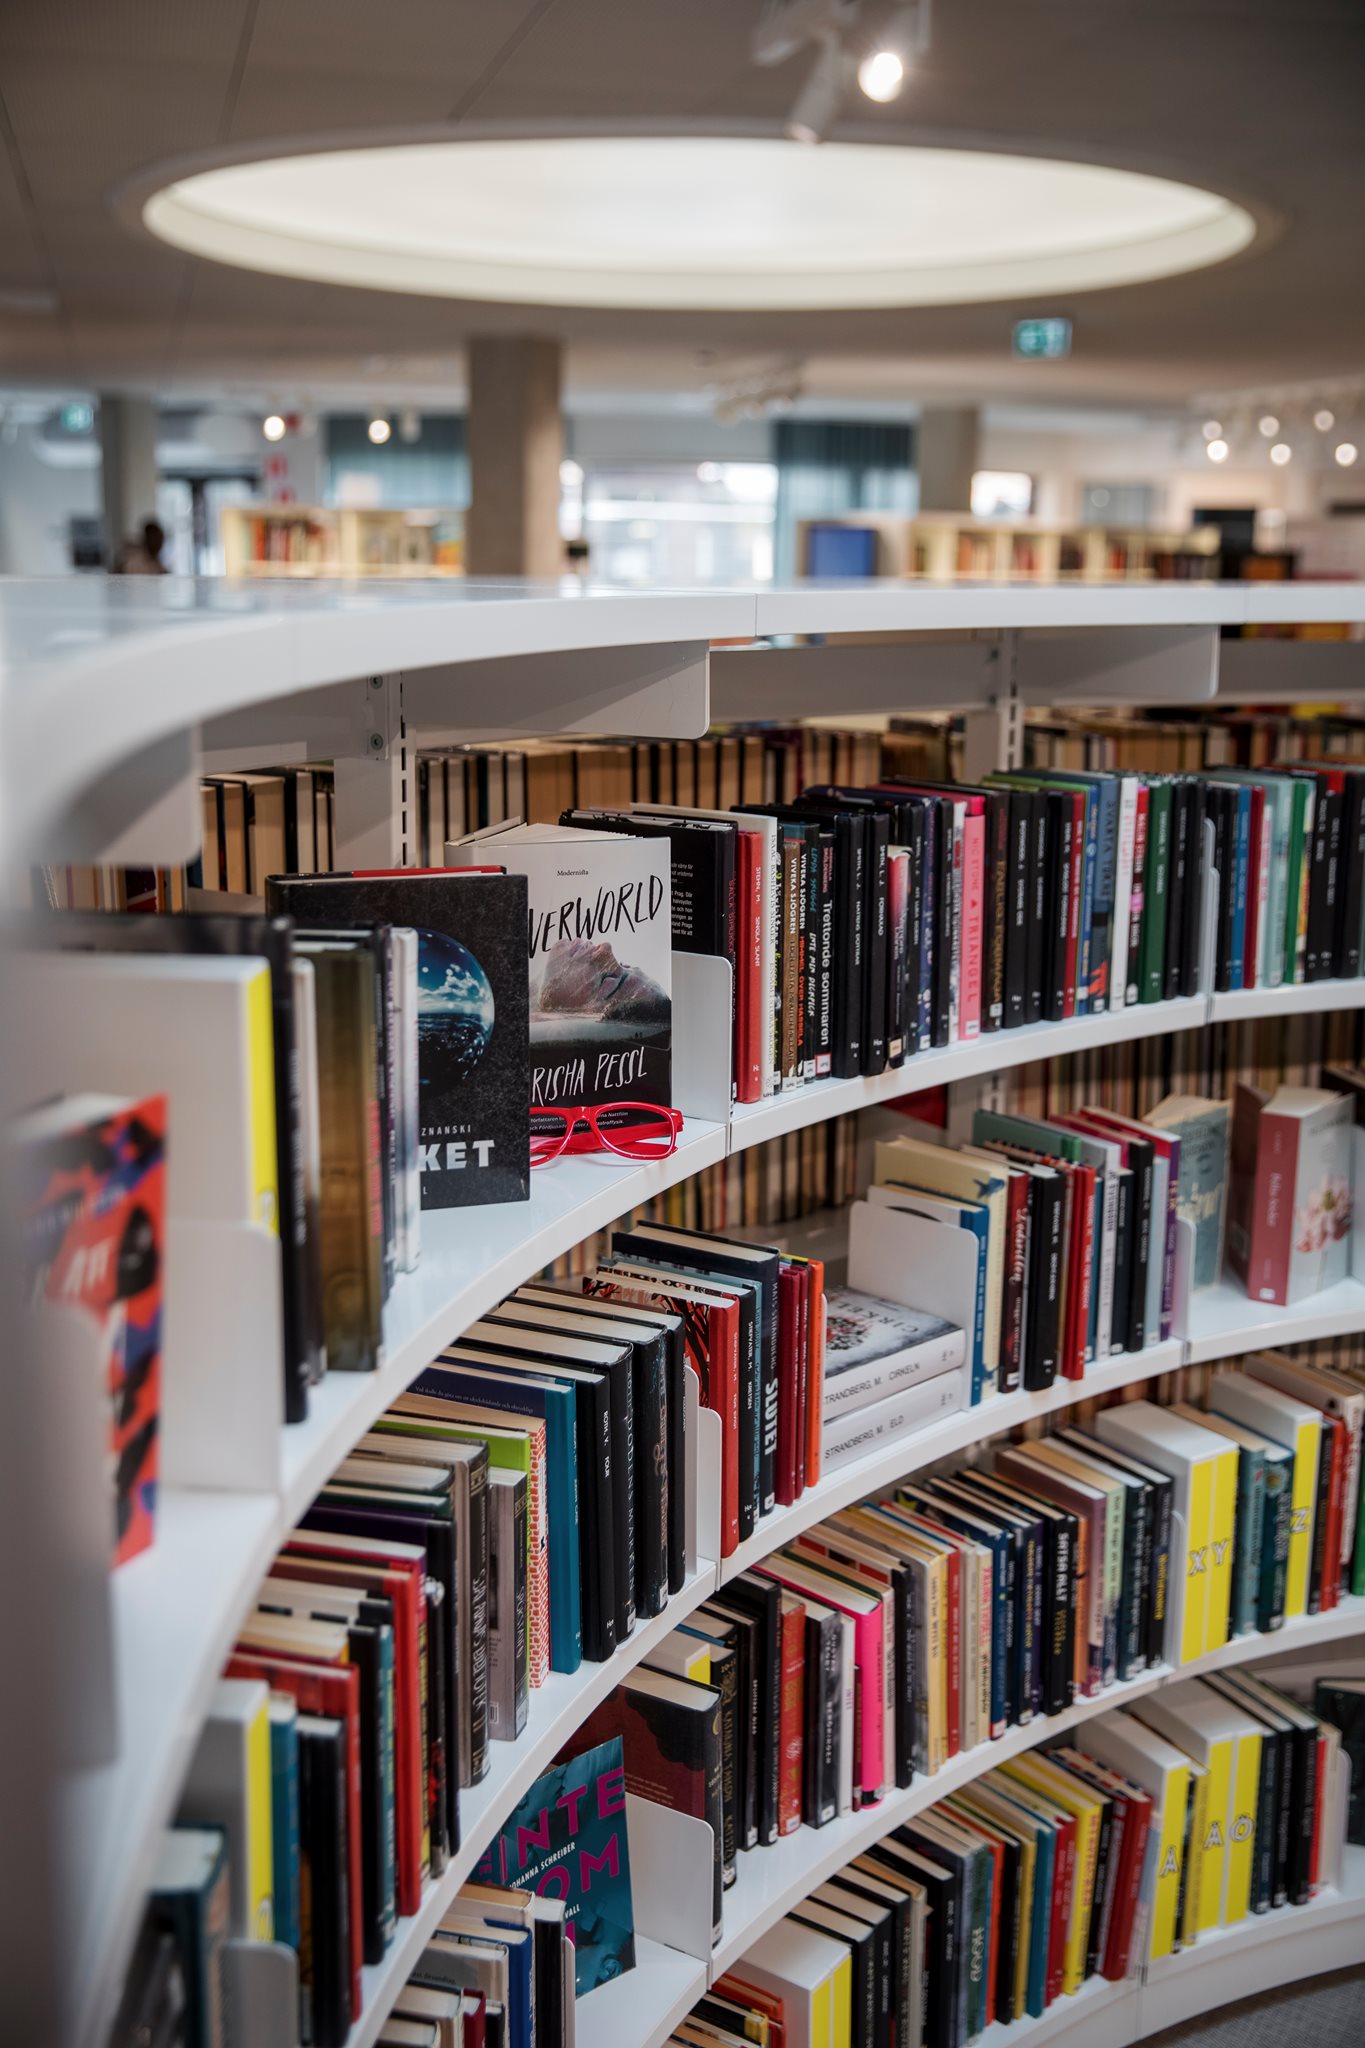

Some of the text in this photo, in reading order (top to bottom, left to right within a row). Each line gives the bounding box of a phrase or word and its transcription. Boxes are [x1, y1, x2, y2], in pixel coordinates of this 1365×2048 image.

[790, 858, 798, 891] VIVEKA
[799, 888, 807, 929] SJÖGREN
[821, 900, 833, 1046] Trettonde sommaren
[967, 915, 980, 1003] TRIANGEL
[594, 1046, 648, 1092] PESSL
[421, 1124, 471, 1137] ZNANSKI
[764, 1377, 779, 1456] SLUTET
[1289, 1506, 1311, 1535] Z
[1057, 1532, 1069, 1572] SATSA
[1188, 1546, 1209, 1577] X
[1210, 1537, 1232, 1567] Y
[1055, 1573, 1068, 1602] ALLT
[509, 1841, 577, 1889] OHANNA SCHREIBER
[969, 1926, 985, 1982] HOOD
